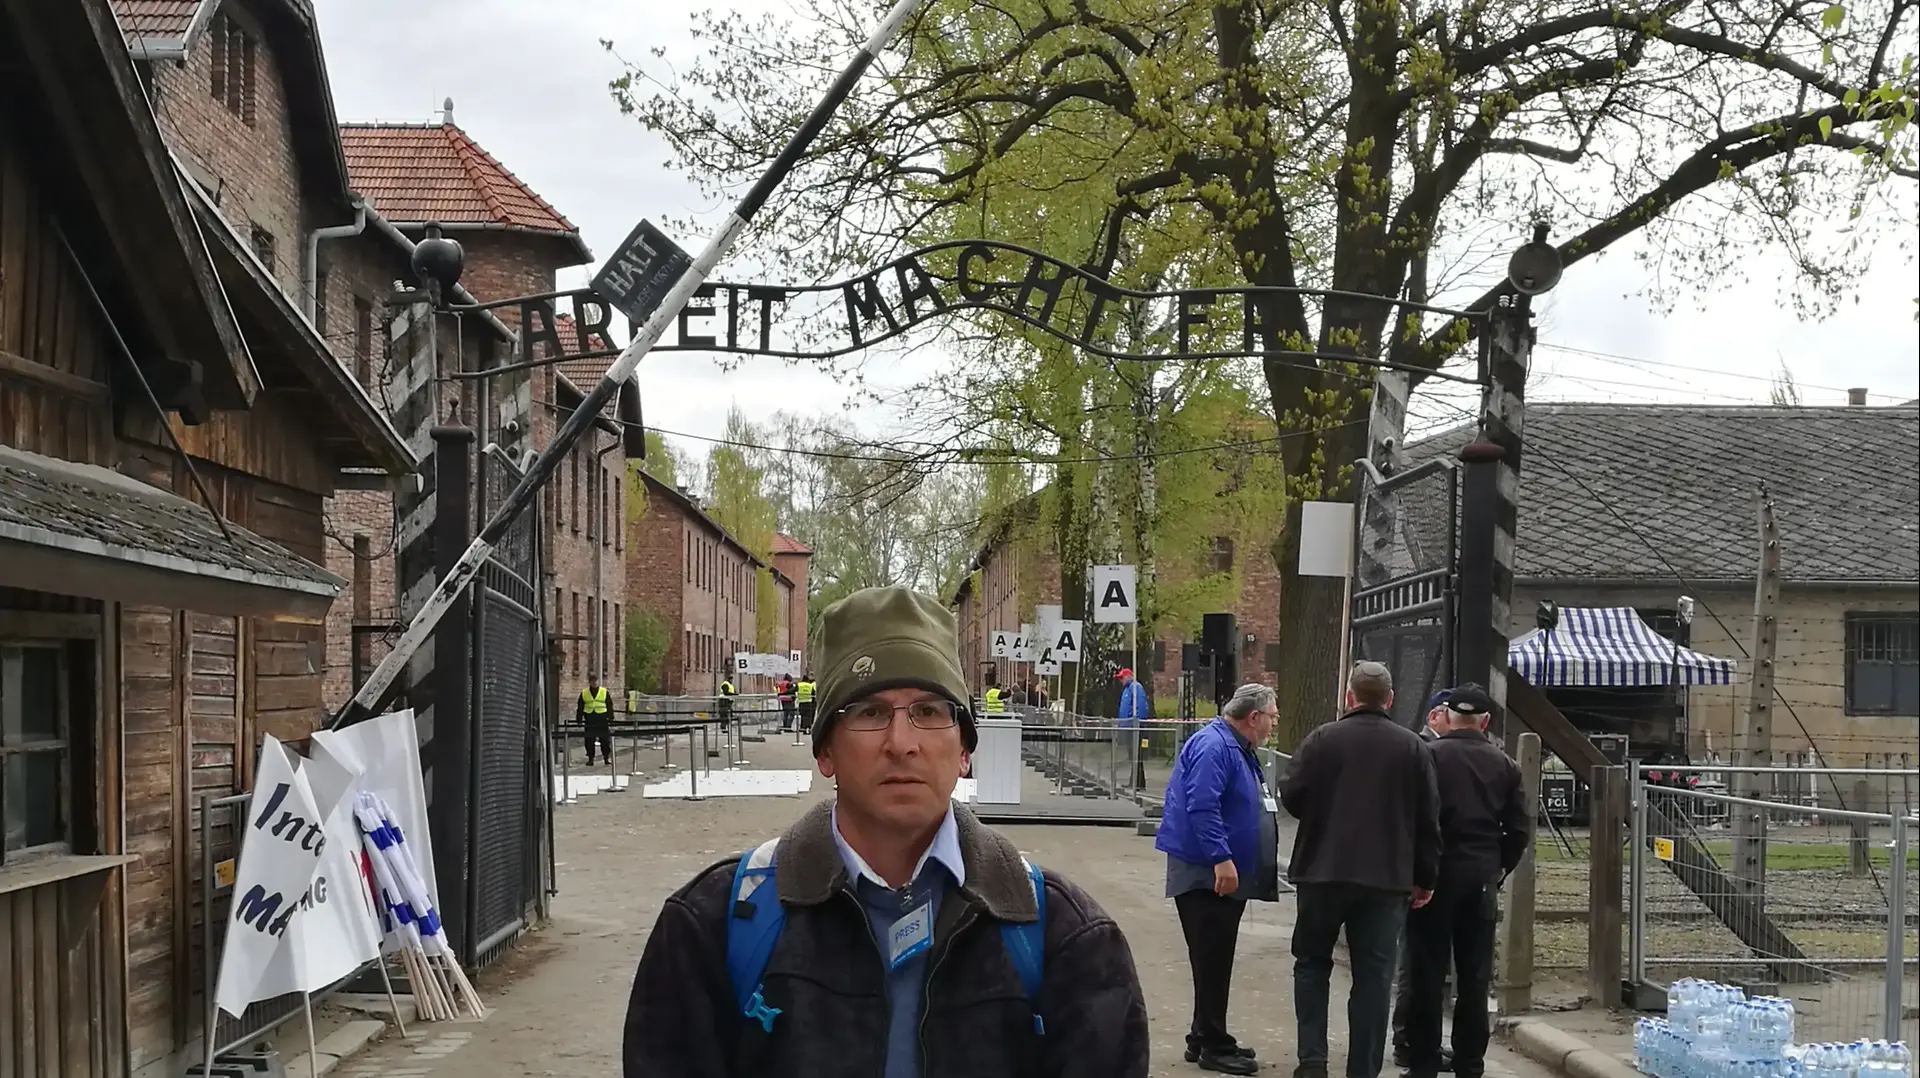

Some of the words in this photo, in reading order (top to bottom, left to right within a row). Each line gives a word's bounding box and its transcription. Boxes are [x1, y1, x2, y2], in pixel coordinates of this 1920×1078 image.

[604, 234, 658, 297] HALT
[522, 288, 786, 361] AREIT
[843, 244, 1121, 347] MACHT
[1101, 580, 1129, 608] A
[995, 635, 1007, 646] A
[1056, 631, 1076, 651] A
[739, 659, 748, 669] B
[792, 653, 800, 661] B
[1039, 647, 1057, 665] A
[895, 920, 920, 944] PRESS
